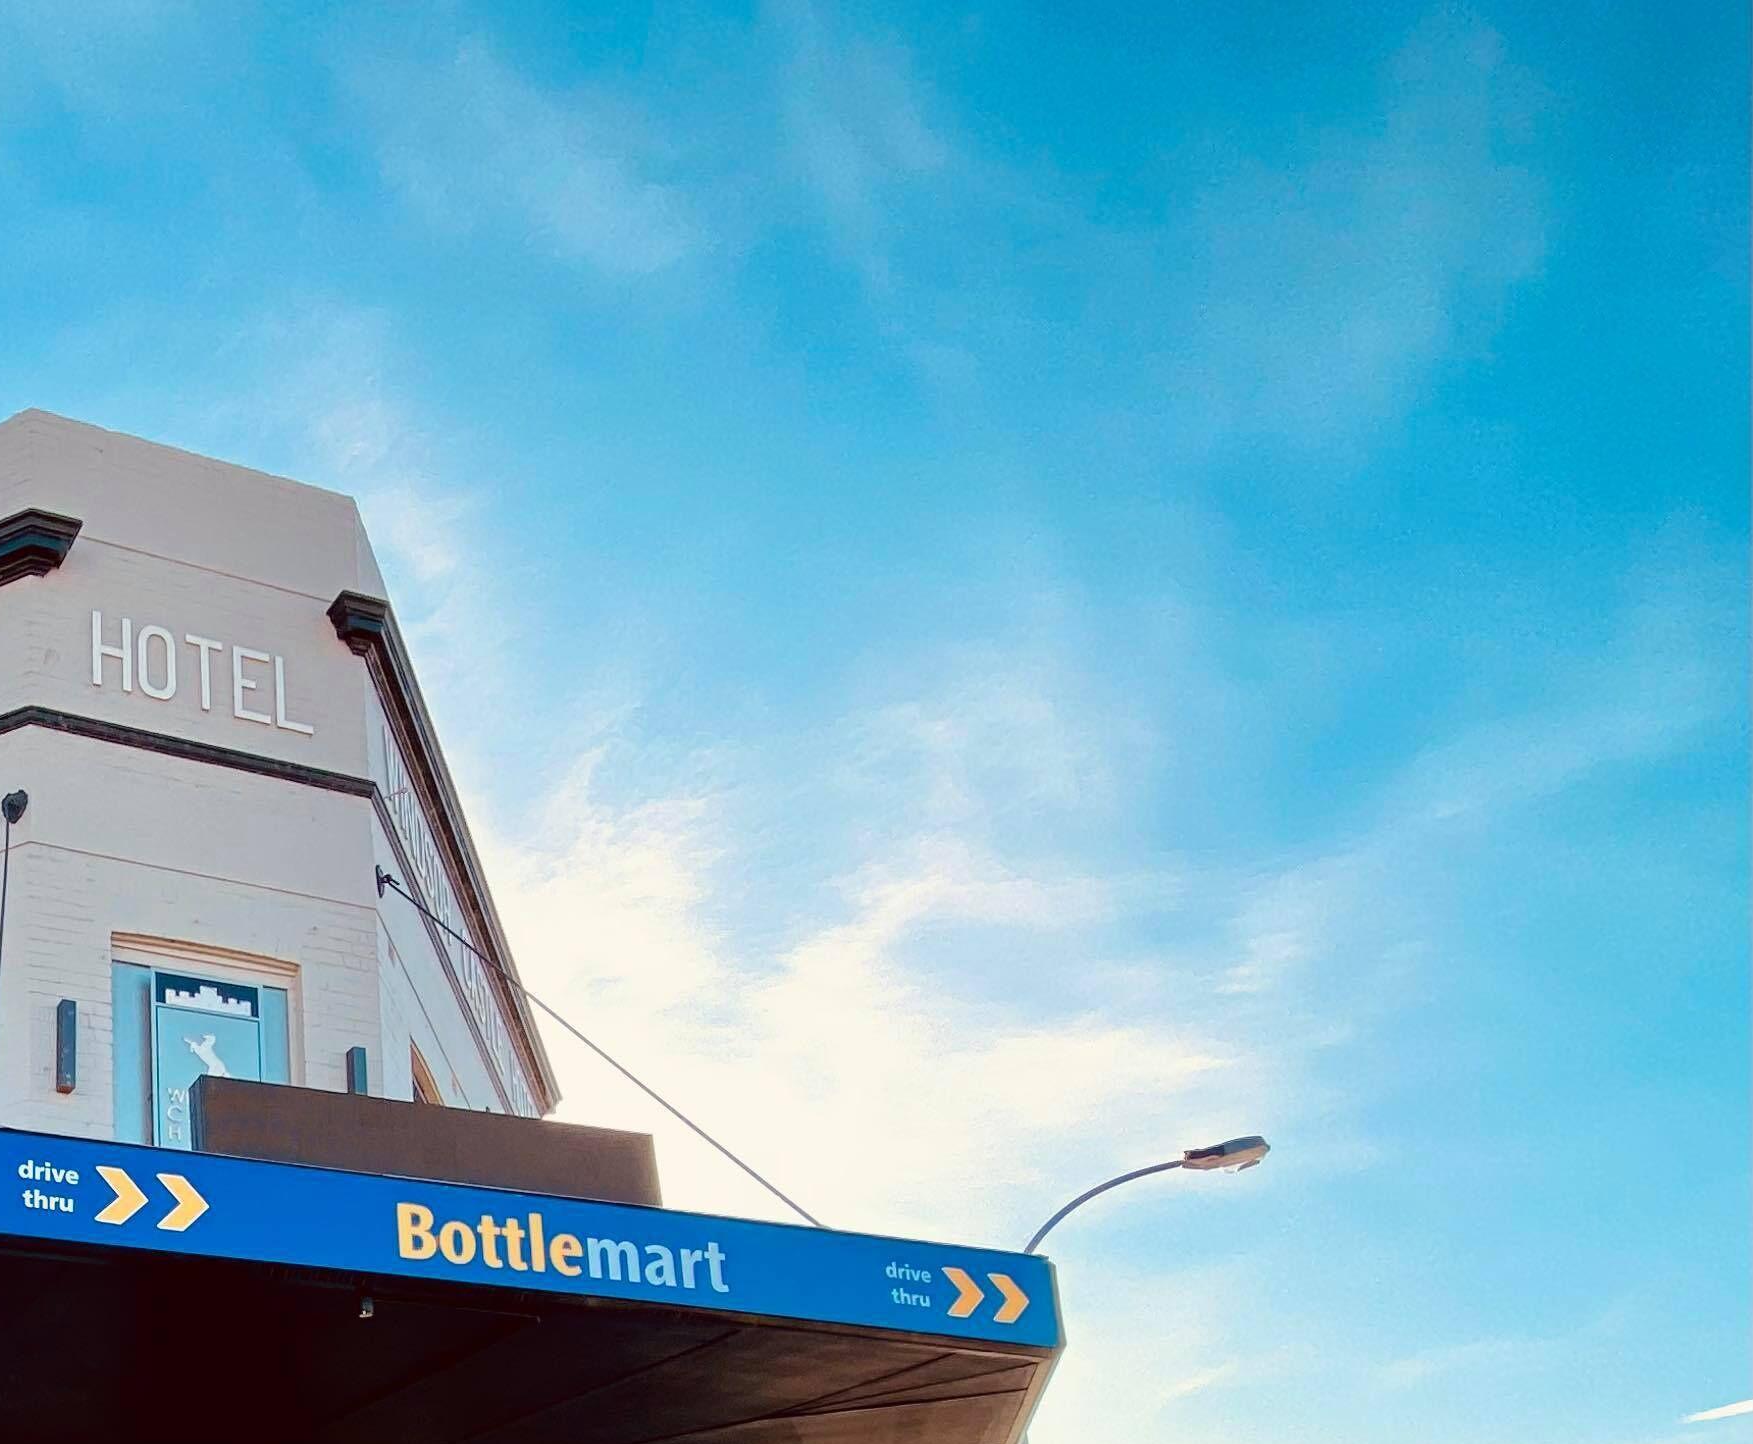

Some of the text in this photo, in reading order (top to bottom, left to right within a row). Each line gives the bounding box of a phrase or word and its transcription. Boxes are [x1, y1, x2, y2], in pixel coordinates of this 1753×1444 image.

[92, 610, 314, 736] HOTEL
[17, 1159, 79, 1186] drive
[22, 1189, 75, 1213] thru
[396, 1202, 730, 1294] Bottlemart
[885, 1261, 932, 1284] drive
[891, 1287, 931, 1307] thru
